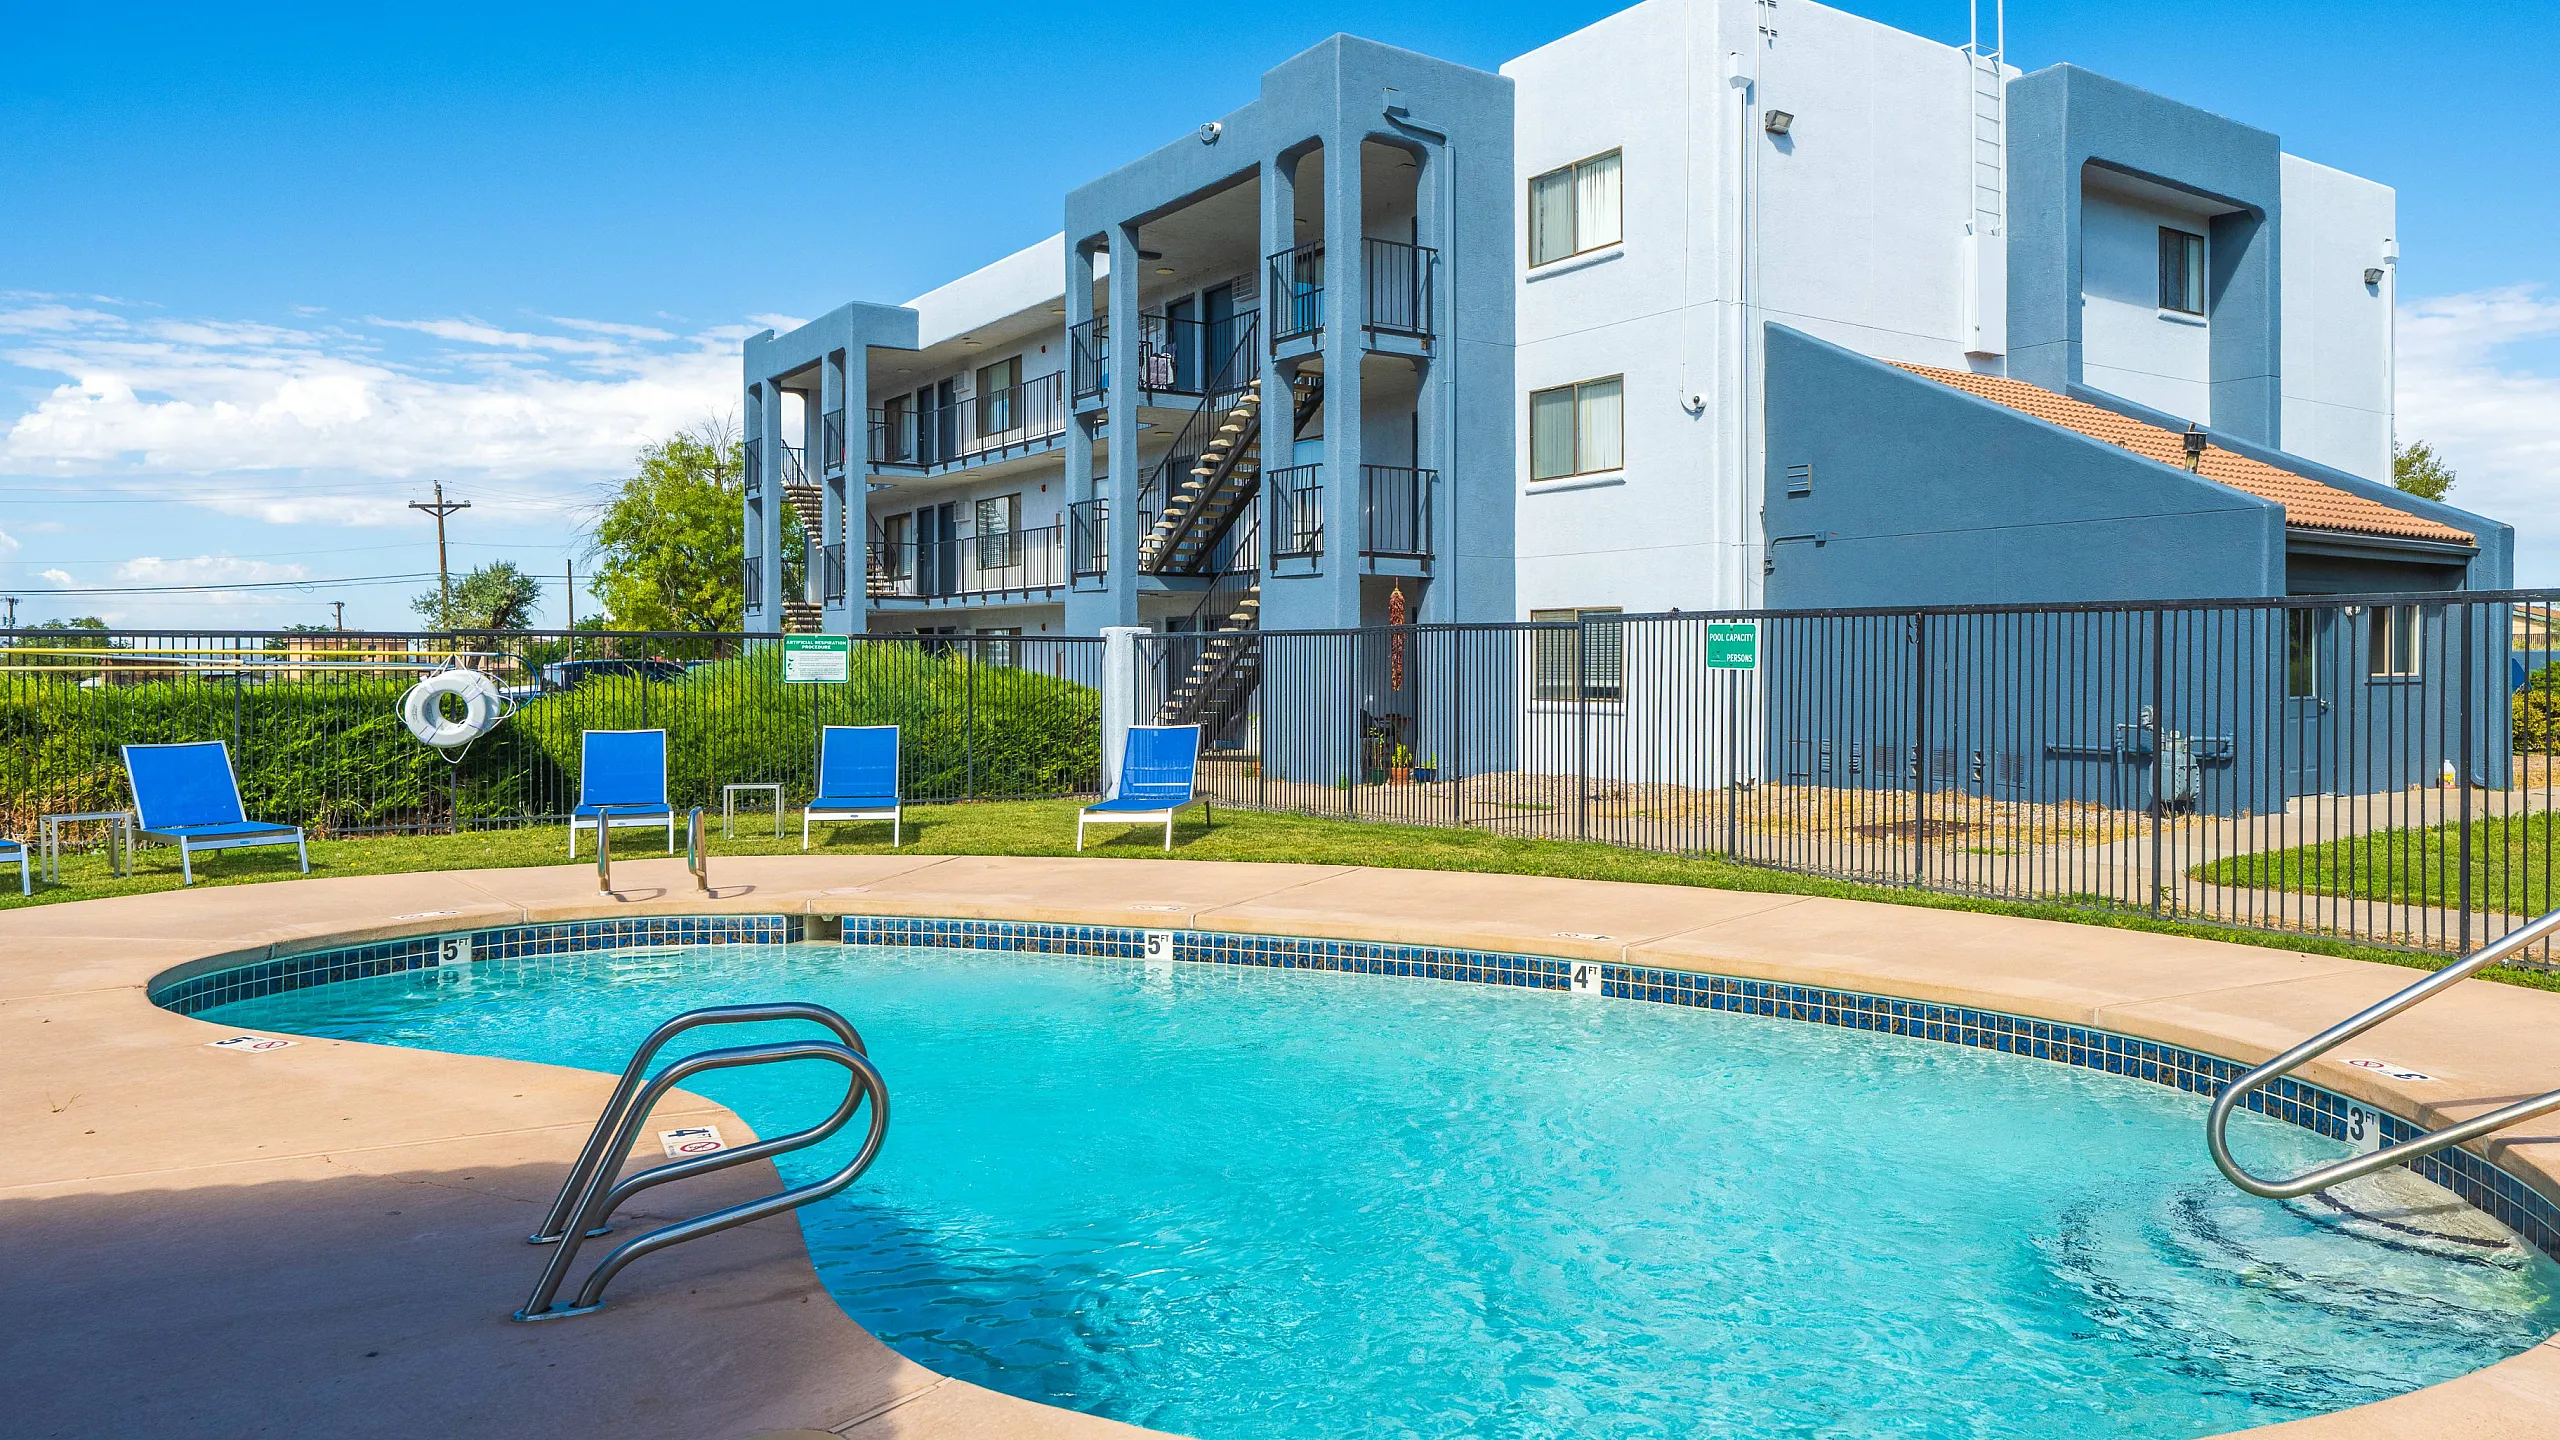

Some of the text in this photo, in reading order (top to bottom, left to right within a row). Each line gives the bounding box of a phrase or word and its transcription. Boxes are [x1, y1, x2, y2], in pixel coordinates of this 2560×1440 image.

[1709, 633, 1754, 642] POOL CAPACITY
[1726, 653, 1753, 663] PERSONS
